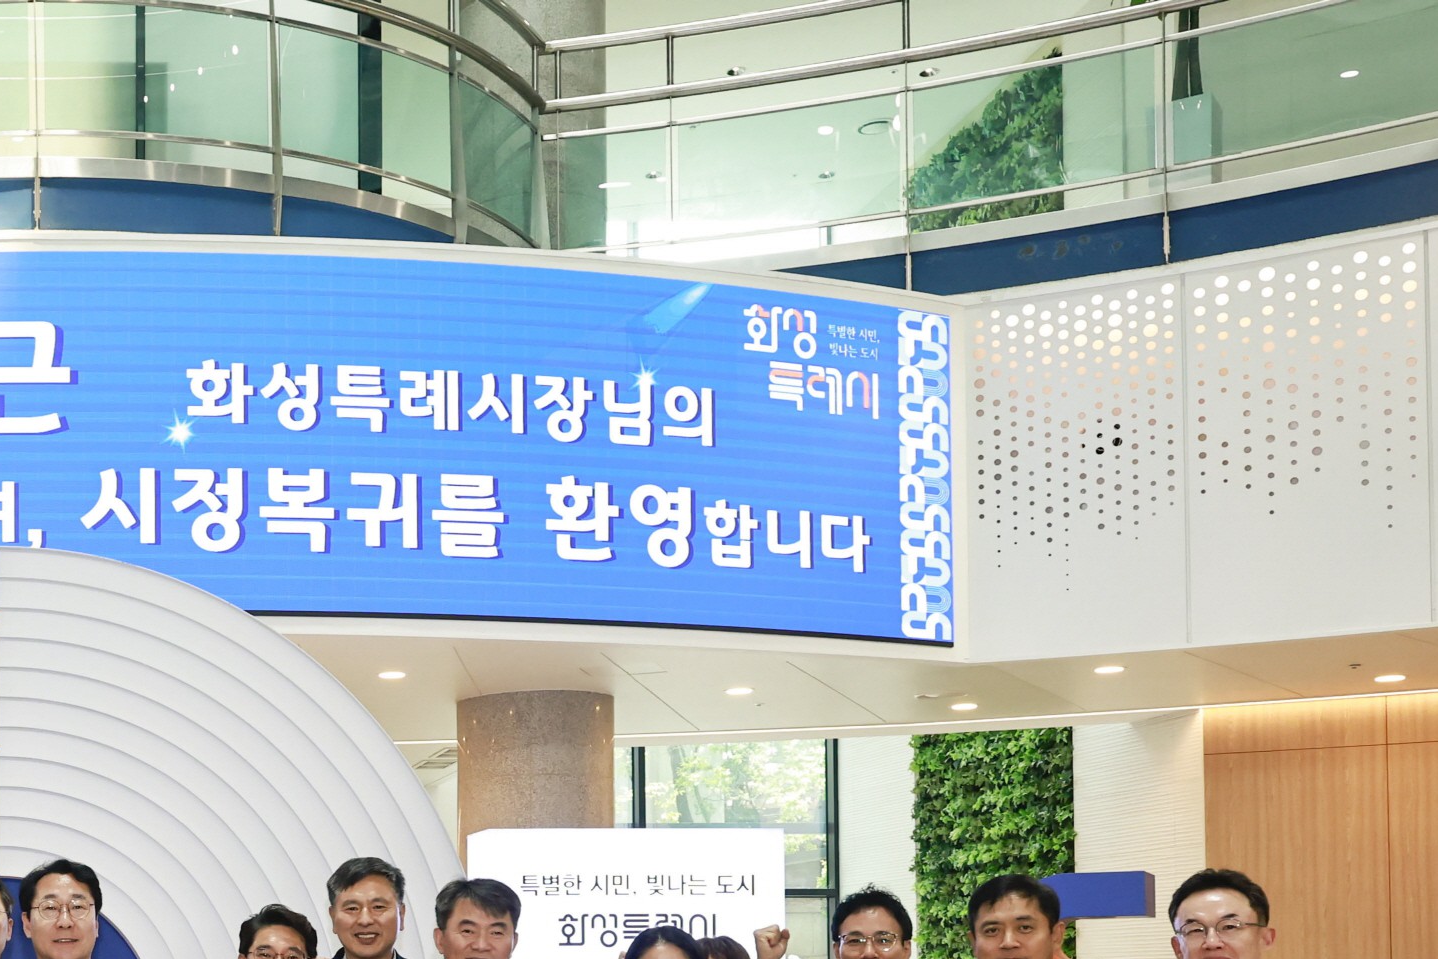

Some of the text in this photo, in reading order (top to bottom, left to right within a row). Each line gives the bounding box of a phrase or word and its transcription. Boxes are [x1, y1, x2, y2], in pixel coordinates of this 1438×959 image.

[743, 304, 818, 360] 화성
[827, 324, 856, 340] 특별한
[829, 342, 878, 361] 빛나는 도시
[185, 359, 715, 447] 화성특례시장님의
[768, 360, 880, 420] 특례시
[80, 466, 506, 560] 시정복귀를
[545, 475, 871, 573] 환영합니다
[519, 874, 583, 896] 특별한
[646, 874, 708, 896] 빛나는
[715, 874, 756, 896] 도시
